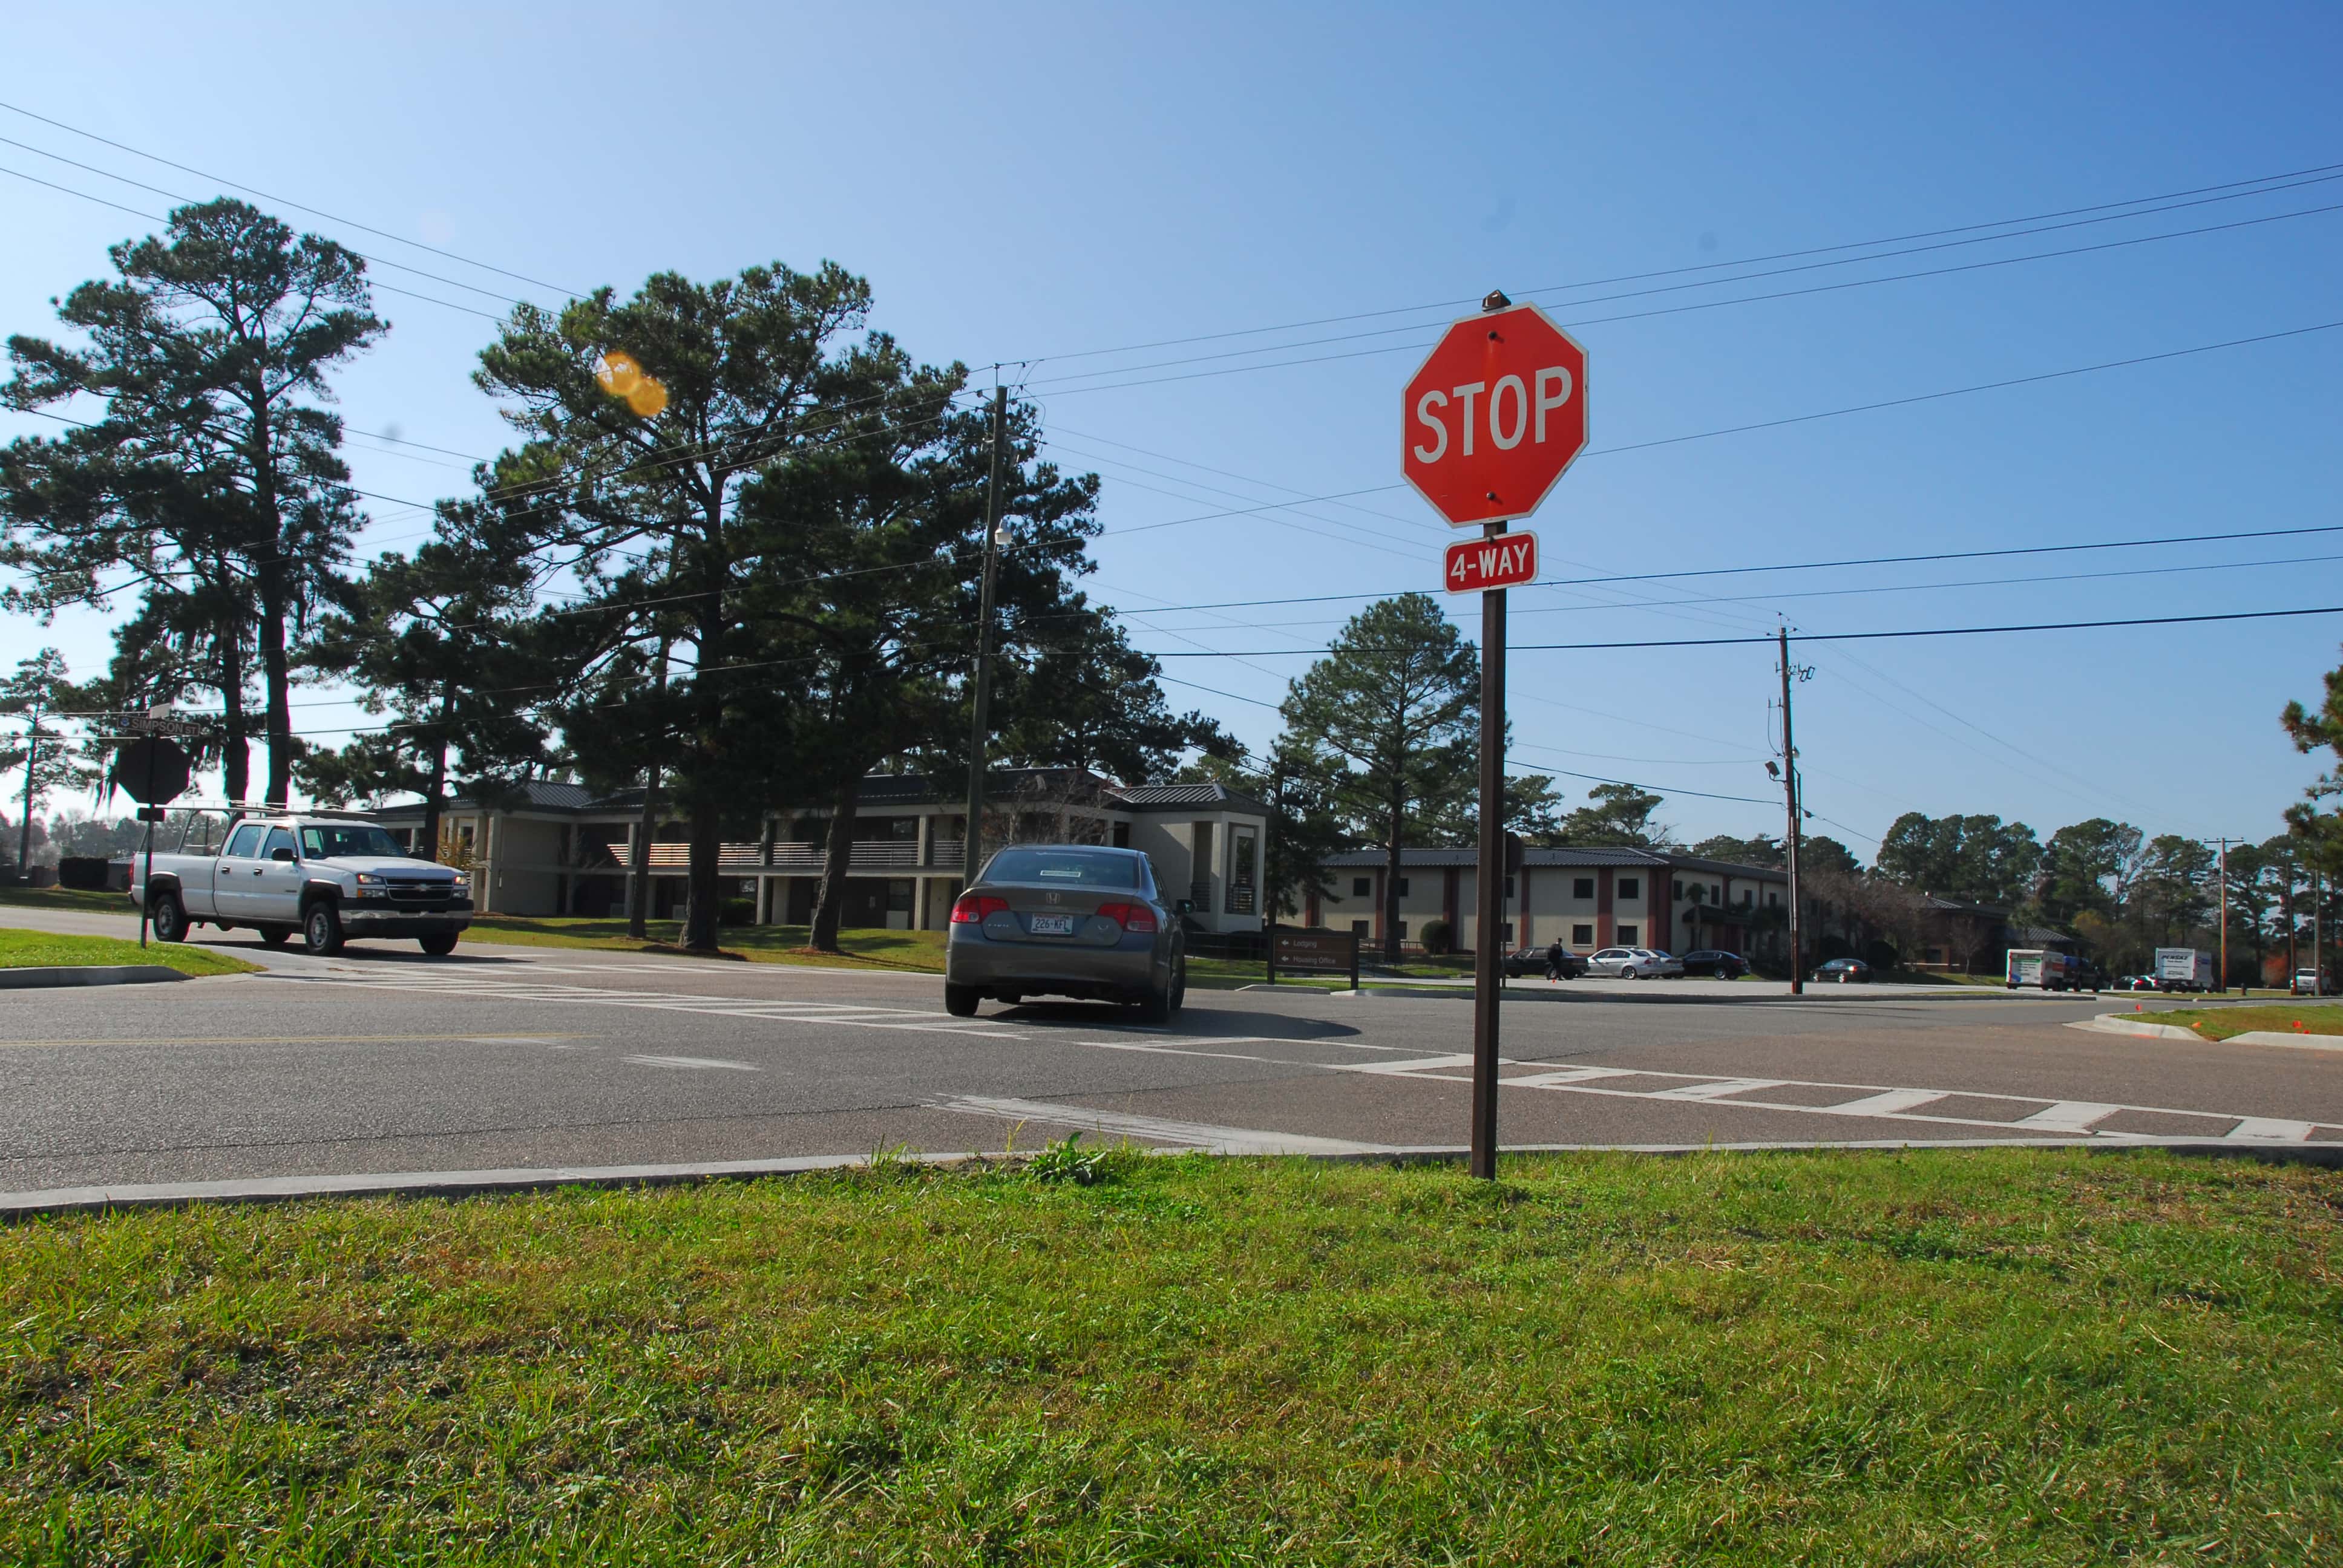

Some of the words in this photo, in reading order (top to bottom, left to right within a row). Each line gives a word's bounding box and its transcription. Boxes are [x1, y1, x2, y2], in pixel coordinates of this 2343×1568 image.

[1414, 365, 1573, 464] STOP
[1450, 543, 1529, 582] 4-WAY
[131, 718, 183, 733] SIMPSON
[185, 726, 196, 734] ST
[1035, 918, 1068, 929] 226-KFL
[1293, 939, 1317, 949] Lodging
[1293, 956, 1317, 965] Housing
